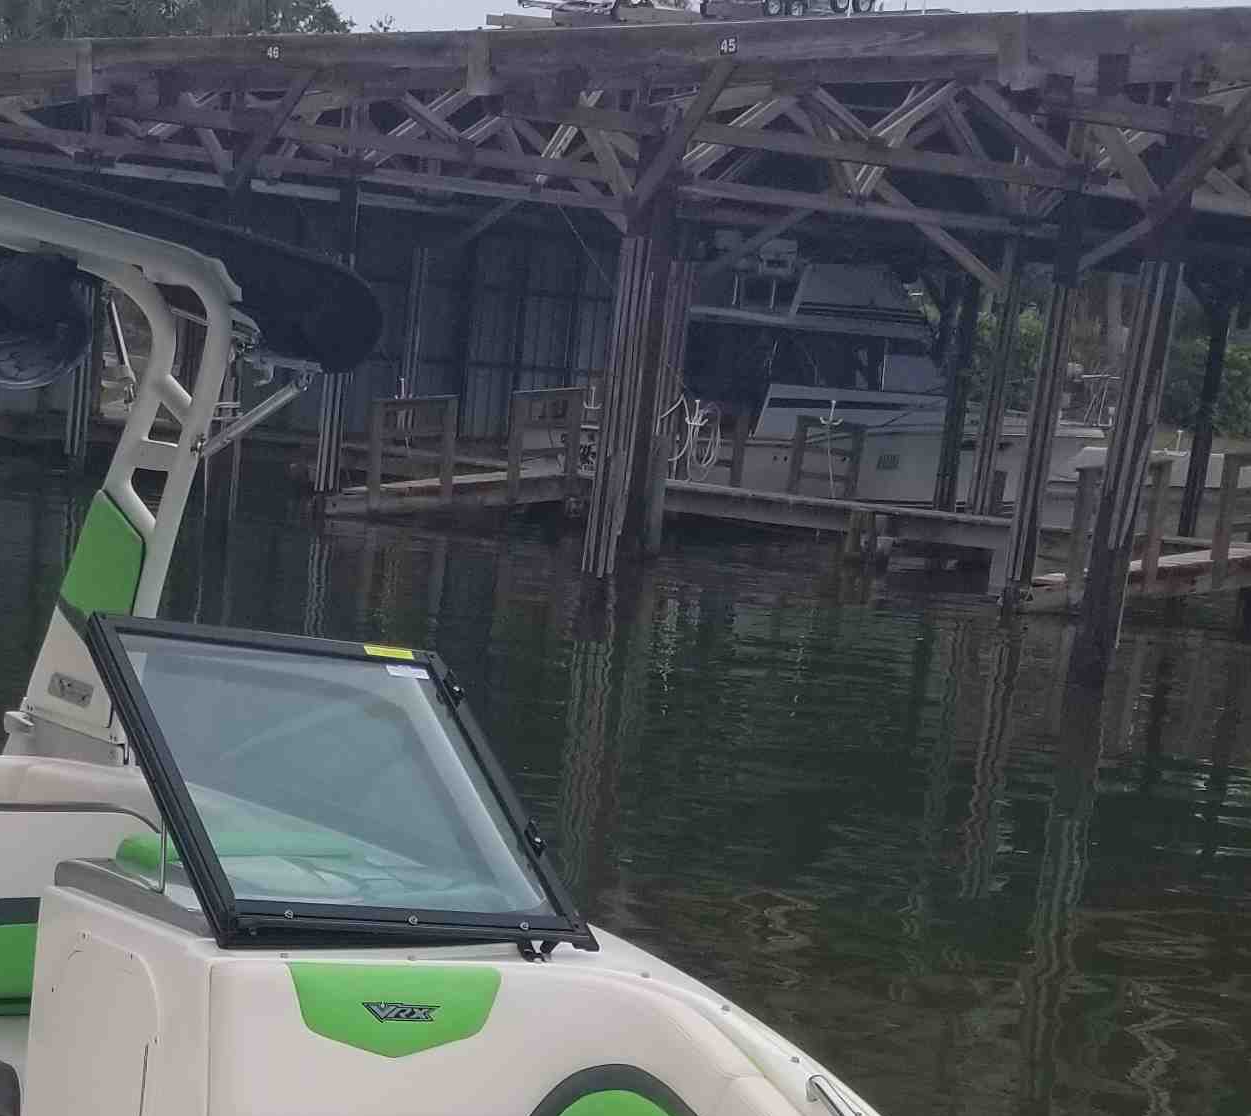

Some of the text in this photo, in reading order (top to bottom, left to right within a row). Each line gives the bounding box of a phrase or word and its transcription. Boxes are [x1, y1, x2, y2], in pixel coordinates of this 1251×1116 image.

[267, 46, 279, 58] 46
[720, 38, 736, 53] 45
[362, 1001, 441, 1023] VRX
